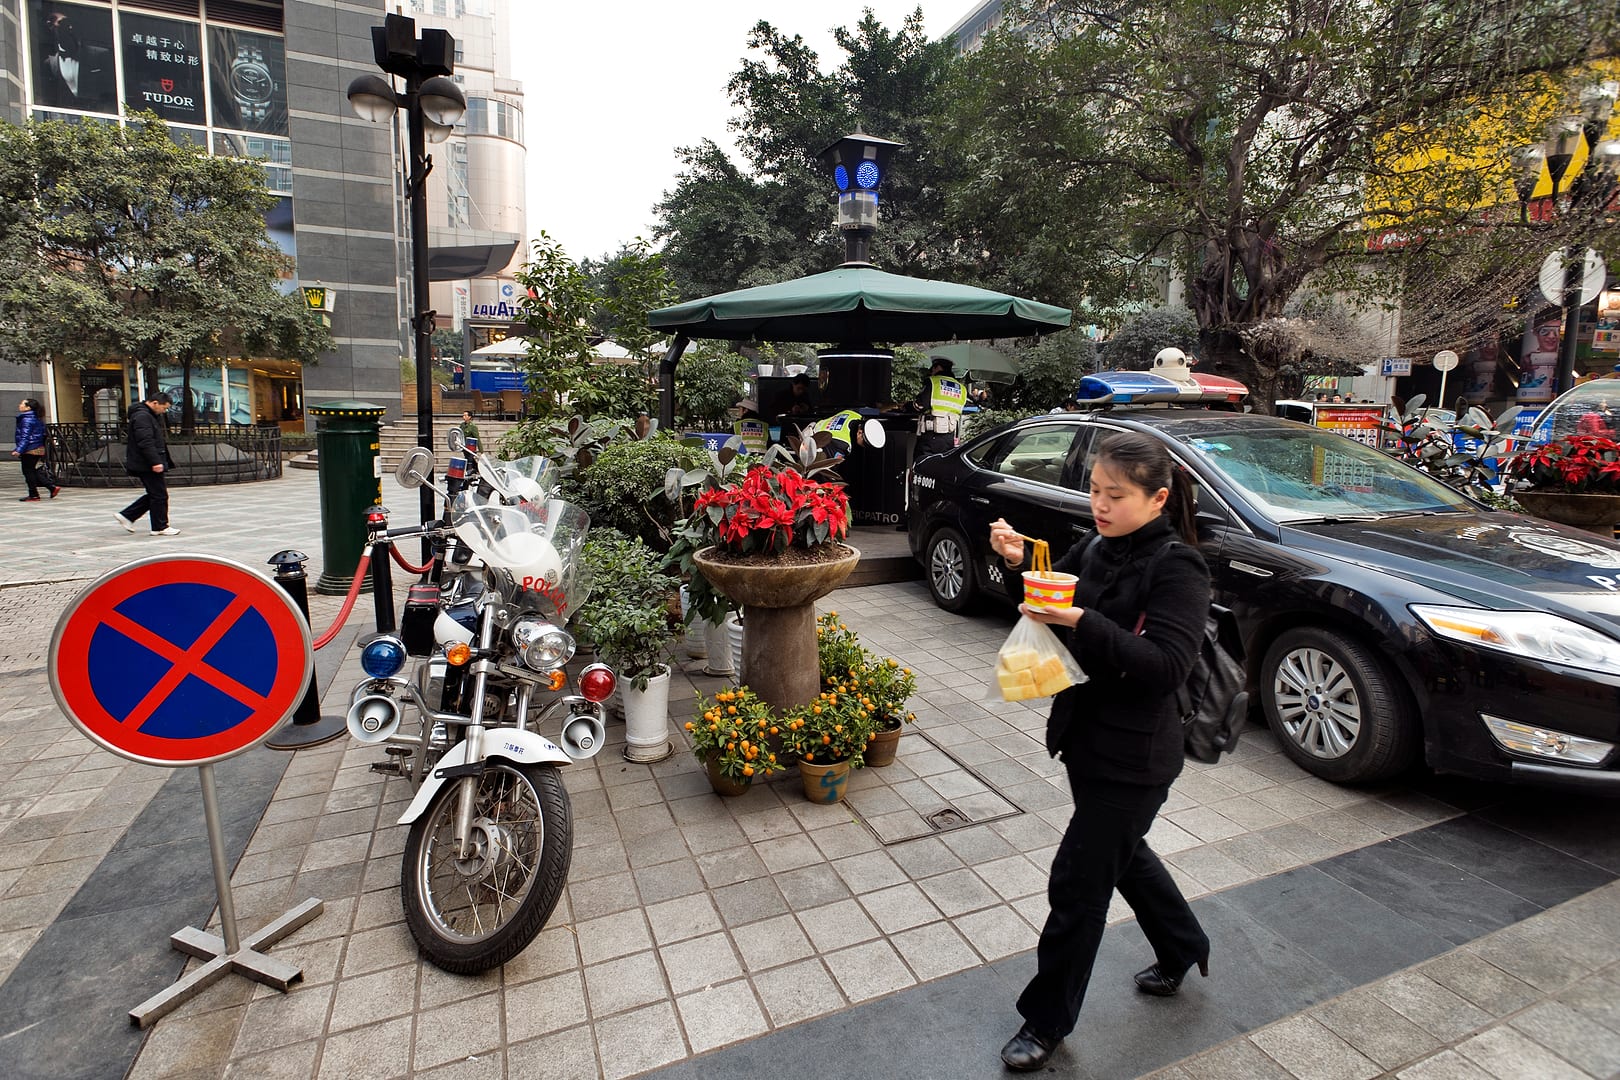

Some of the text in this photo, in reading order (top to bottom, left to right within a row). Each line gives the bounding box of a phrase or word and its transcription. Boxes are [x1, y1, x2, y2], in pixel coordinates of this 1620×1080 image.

[132, 33, 185, 50] 卓越于心
[146, 49, 199, 66] 精致以形
[142, 91, 194, 107] TUDOR
[522, 575, 569, 616] POLICE
